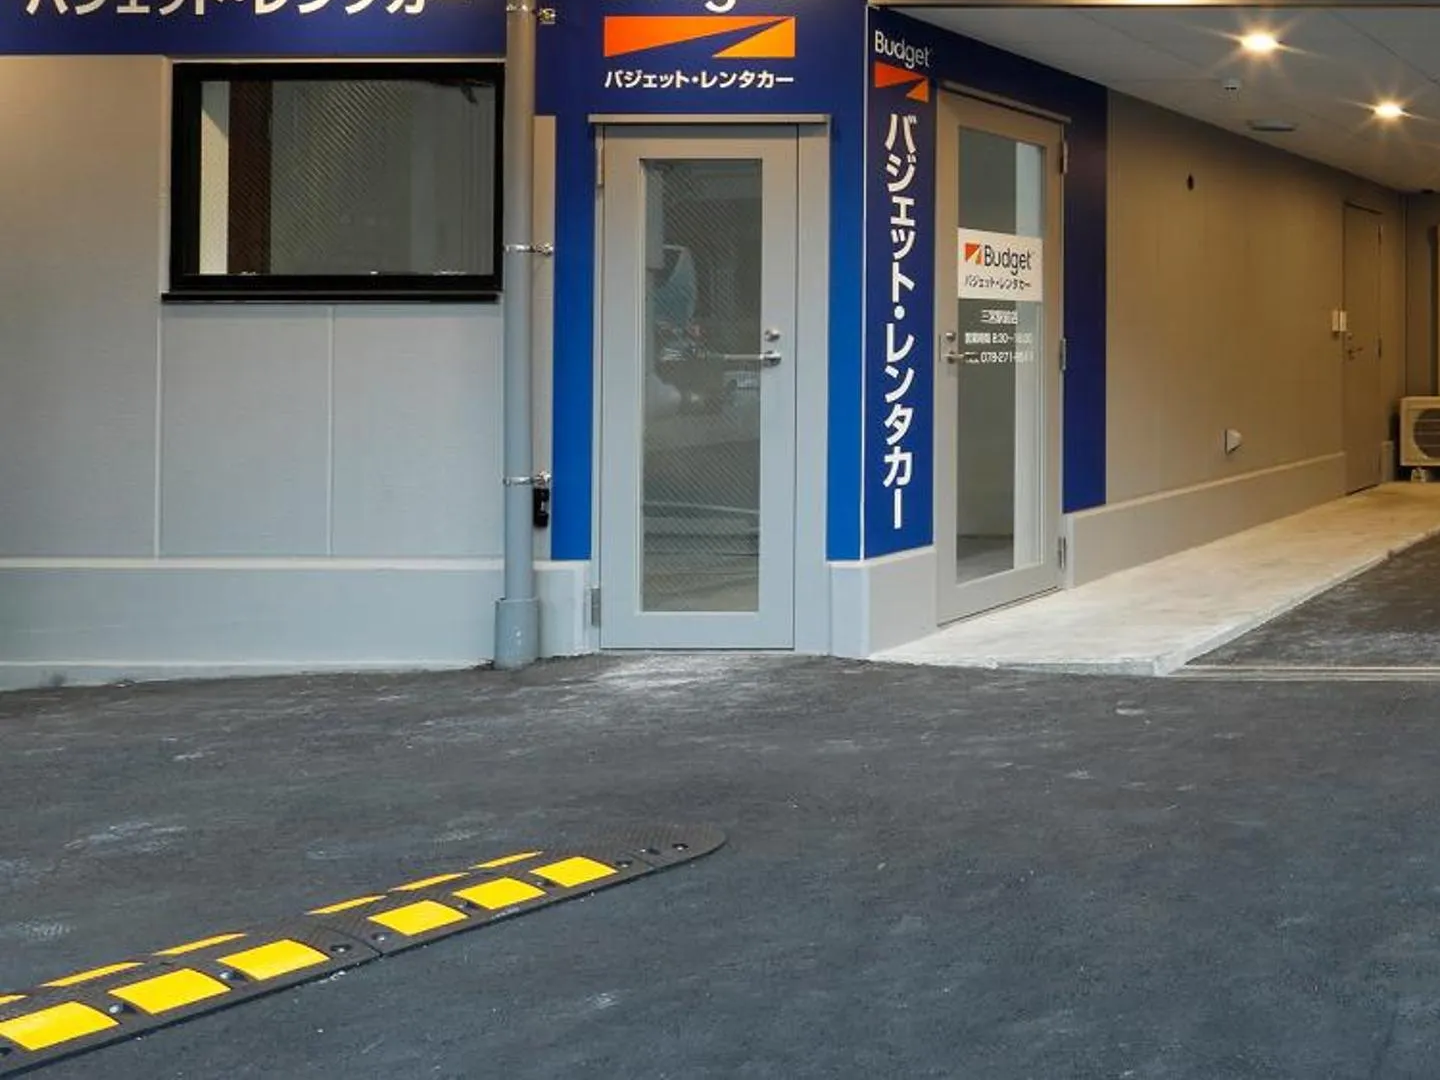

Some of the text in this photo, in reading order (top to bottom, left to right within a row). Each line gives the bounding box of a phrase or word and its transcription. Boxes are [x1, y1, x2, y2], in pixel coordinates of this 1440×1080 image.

[874, 29, 930, 69] Budget
[604, 70, 794, 89] バジェット・レンタカー
[984, 244, 1032, 276] Budget
[883, 113, 917, 530] バジェット・レンタカー
